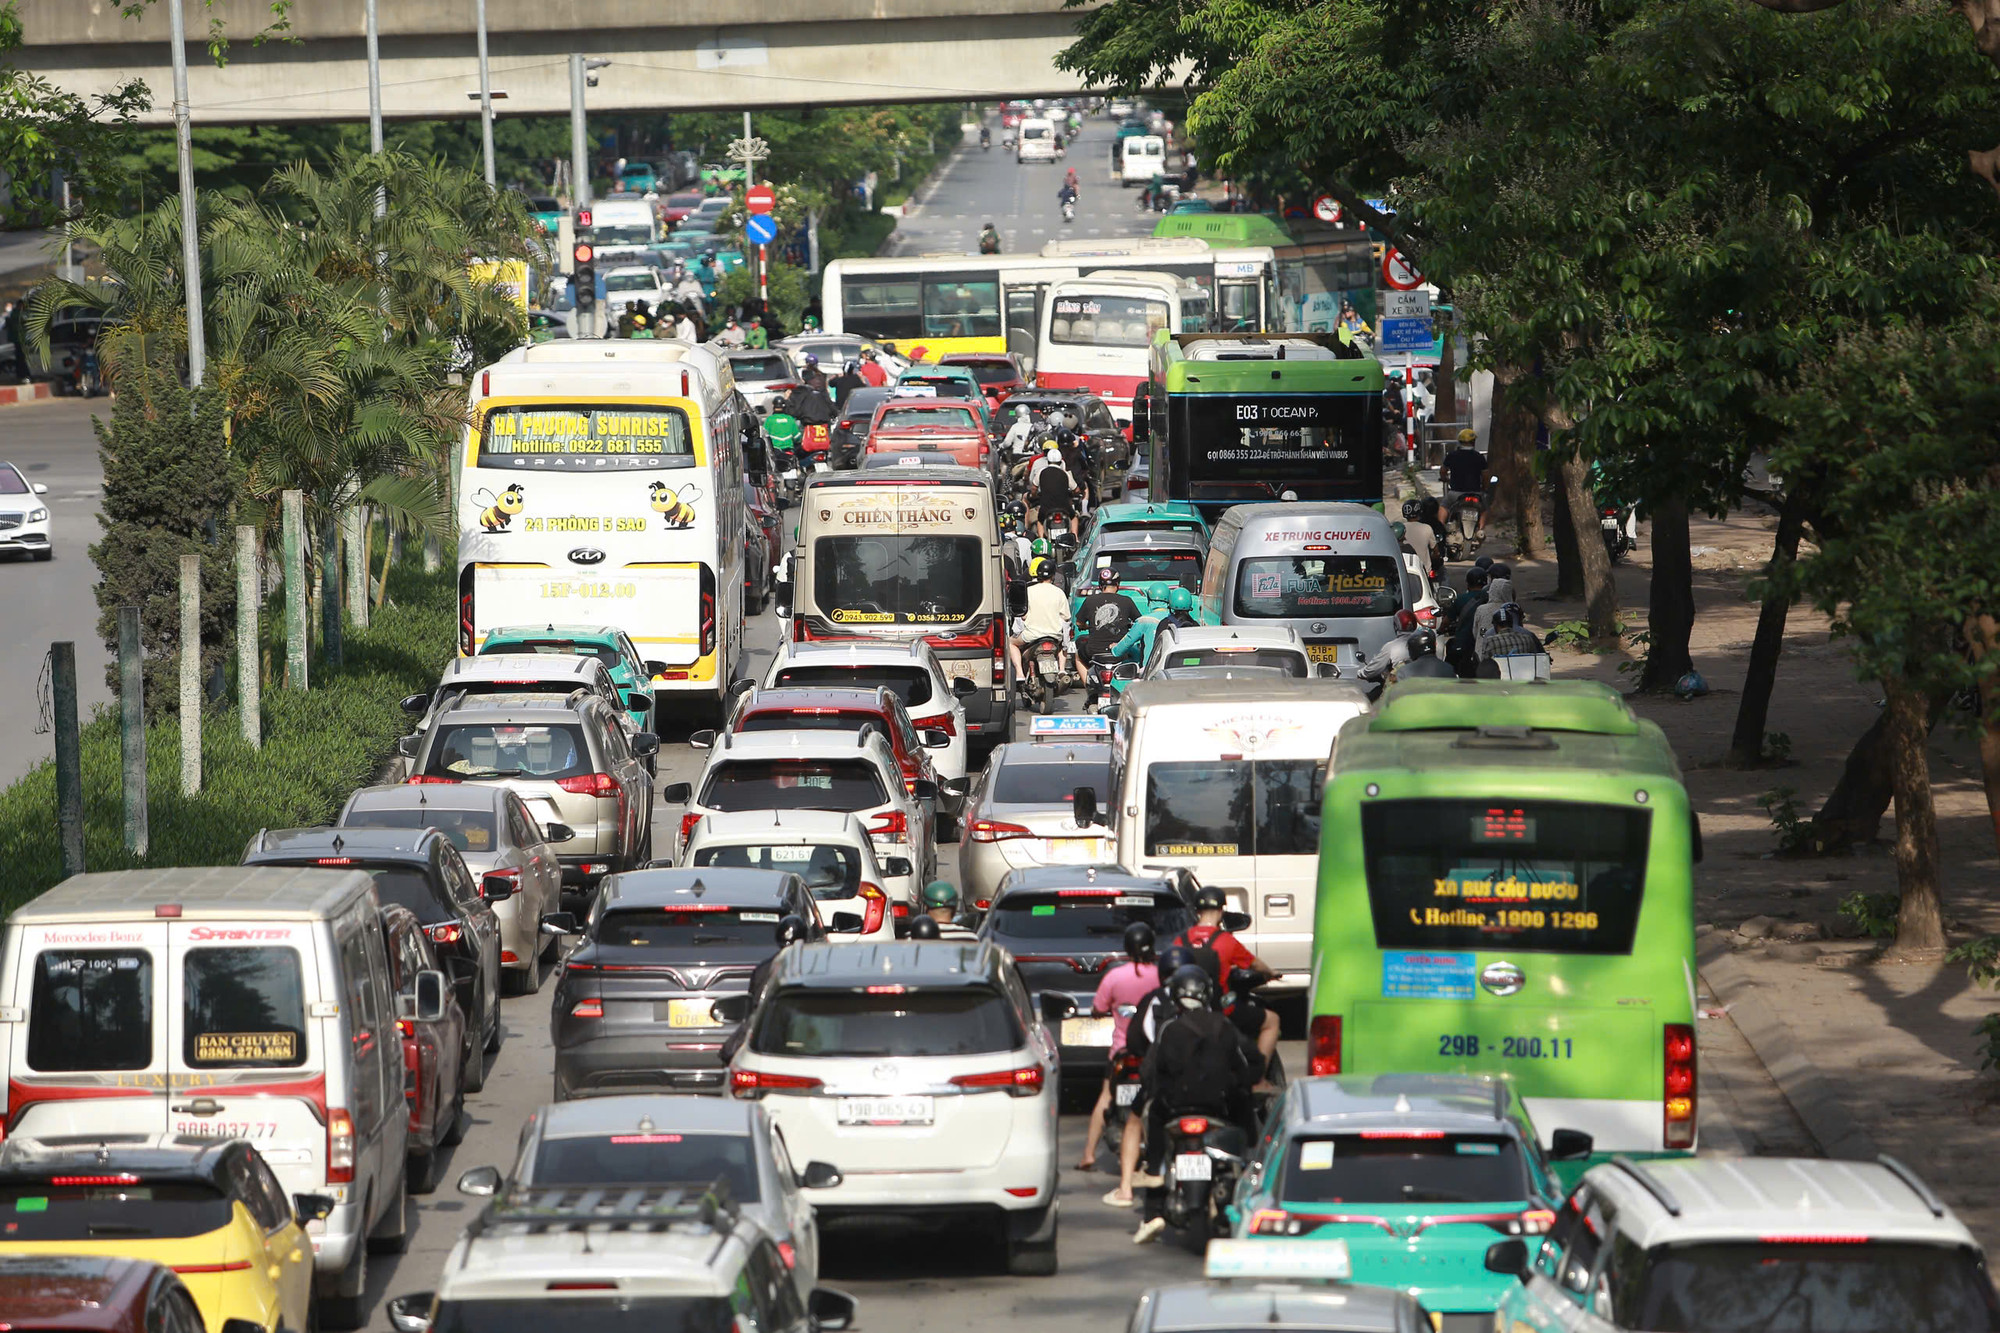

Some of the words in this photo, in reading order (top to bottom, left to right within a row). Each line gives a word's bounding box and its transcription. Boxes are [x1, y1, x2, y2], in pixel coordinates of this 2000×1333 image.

[1398, 294, 1416, 304] CẤM
[1392, 307, 1403, 315] XE
[1405, 306, 1424, 314] TAXI
[1236, 405, 1258, 420] E03
[1271, 407, 1306, 418] OCEAN
[495, 415, 517, 436] HÀ
[522, 415, 589, 436] PHƯƠNG
[597, 417, 669, 436] SUNRISE
[512, 440, 565, 453] Hotline:
[569, 440, 603, 453] 0922
[607, 440, 632, 453] 681
[636, 440, 662, 453] 555
[1219, 449, 1235, 460] 0866
[1236, 449, 1249, 460] 355
[514, 458, 660, 466] GRANBIRD
[843, 508, 893, 523] CHIẾN
[525, 518, 544, 531] 24
[547, 515, 599, 531] PHÒNG
[603, 518, 612, 531] 5
[616, 518, 647, 531] SAO
[1265, 531, 1279, 541] XE
[1281, 531, 1322, 541] TRUNG
[1324, 528, 1372, 541] CHUYỂN
[539, 583, 636, 598] 15F-012.00
[1287, 579, 1322, 593] FUTA
[1326, 574, 1386, 592] HàSơn
[776, 850, 810, 860] 621.61
[1169, 845, 1194, 854] 0848
[1217, 845, 1235, 854] 555
[1497, 910, 1545, 928] 1900
[1550, 911, 1599, 929] 1296
[43, 931, 143, 944] Mercedes-Benz
[187, 926, 292, 941] SPRINTER
[1439, 1035, 1479, 1056] 29B
[1503, 1036, 1573, 1059] 200.11
[117, 1073, 218, 1087] LUXURY
